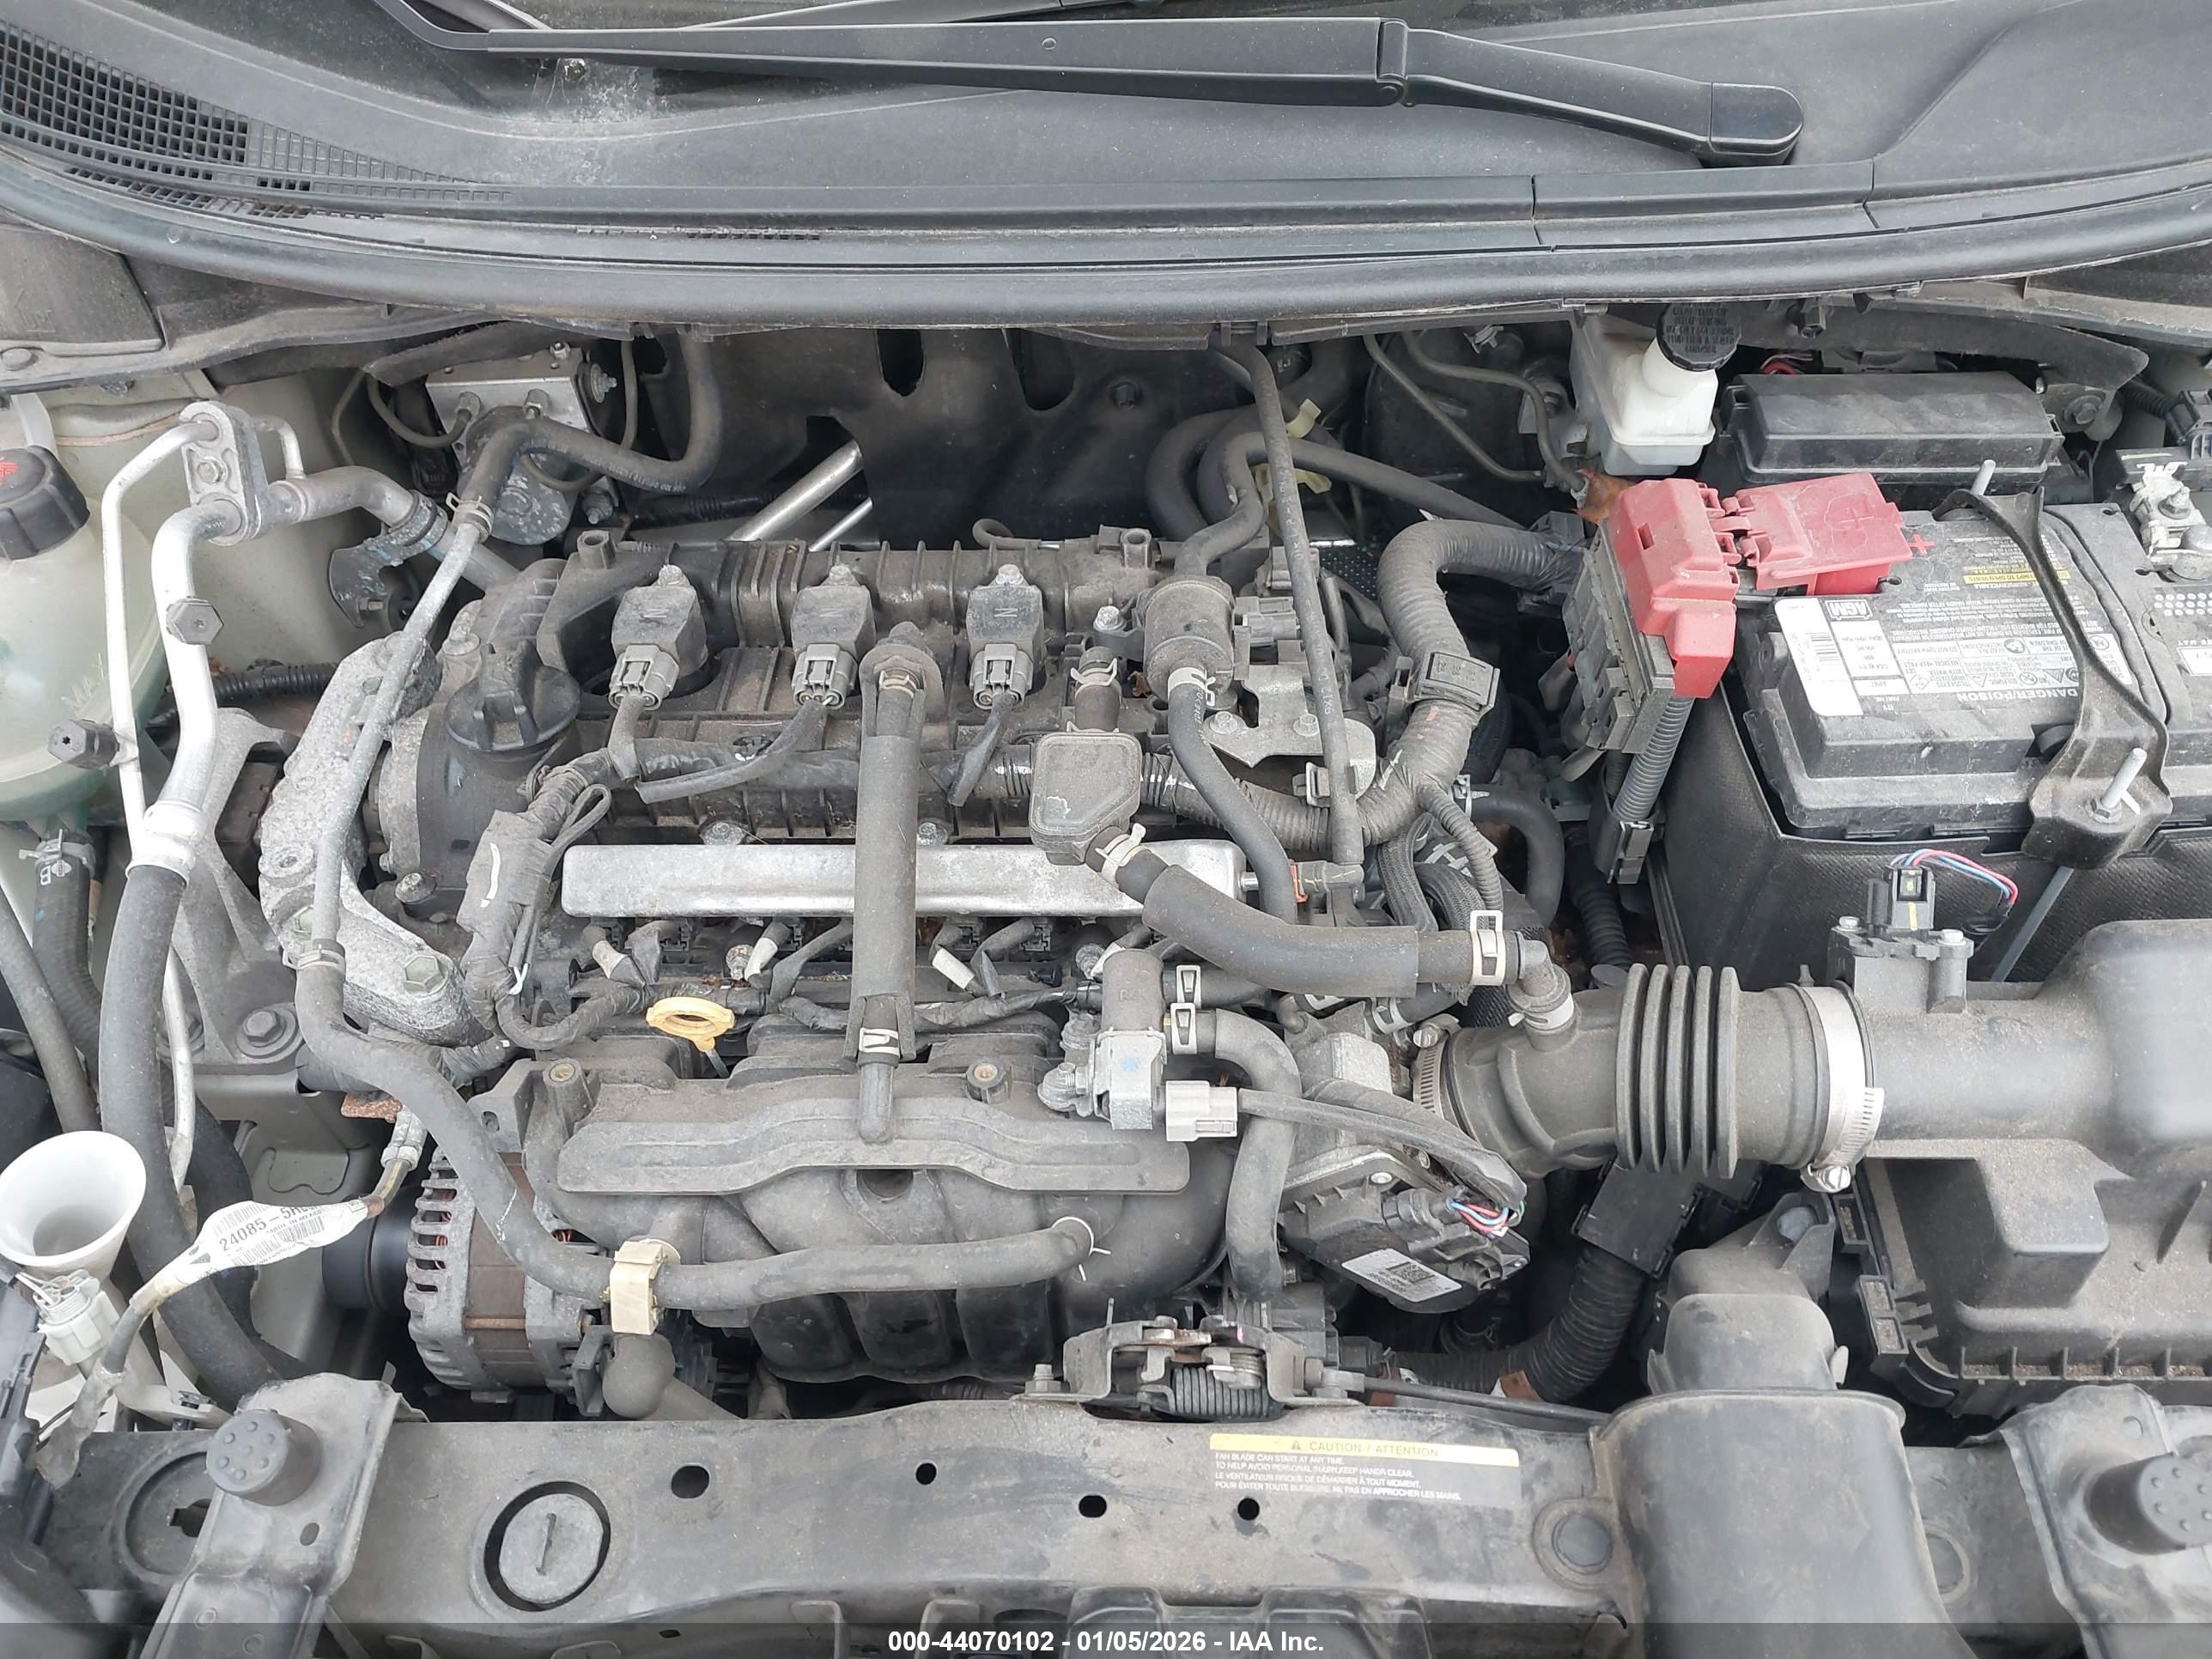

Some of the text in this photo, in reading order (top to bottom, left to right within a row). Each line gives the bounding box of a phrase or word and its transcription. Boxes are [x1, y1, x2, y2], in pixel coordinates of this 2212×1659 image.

[1956, 687, 2078, 702] DANGER/POISON
[1310, 1441, 1361, 1452] CAUTION
[1376, 1444, 1439, 1457] ATTENTION
[1310, 1455, 1326, 1464] ANY
[1227, 1462, 1247, 1470] HELP
[1387, 1468, 1414, 1478] CLEAR.
[1225, 1472, 1274, 1481] VENTILATEUR
[1367, 1477, 1386, 1486] TOUT
[1215, 1480, 1237, 1489] POUR
[1265, 1483, 1289, 1492] TOUTE
[1361, 1486, 1372, 1495] EN
[1421, 1490, 1436, 1499] LES
